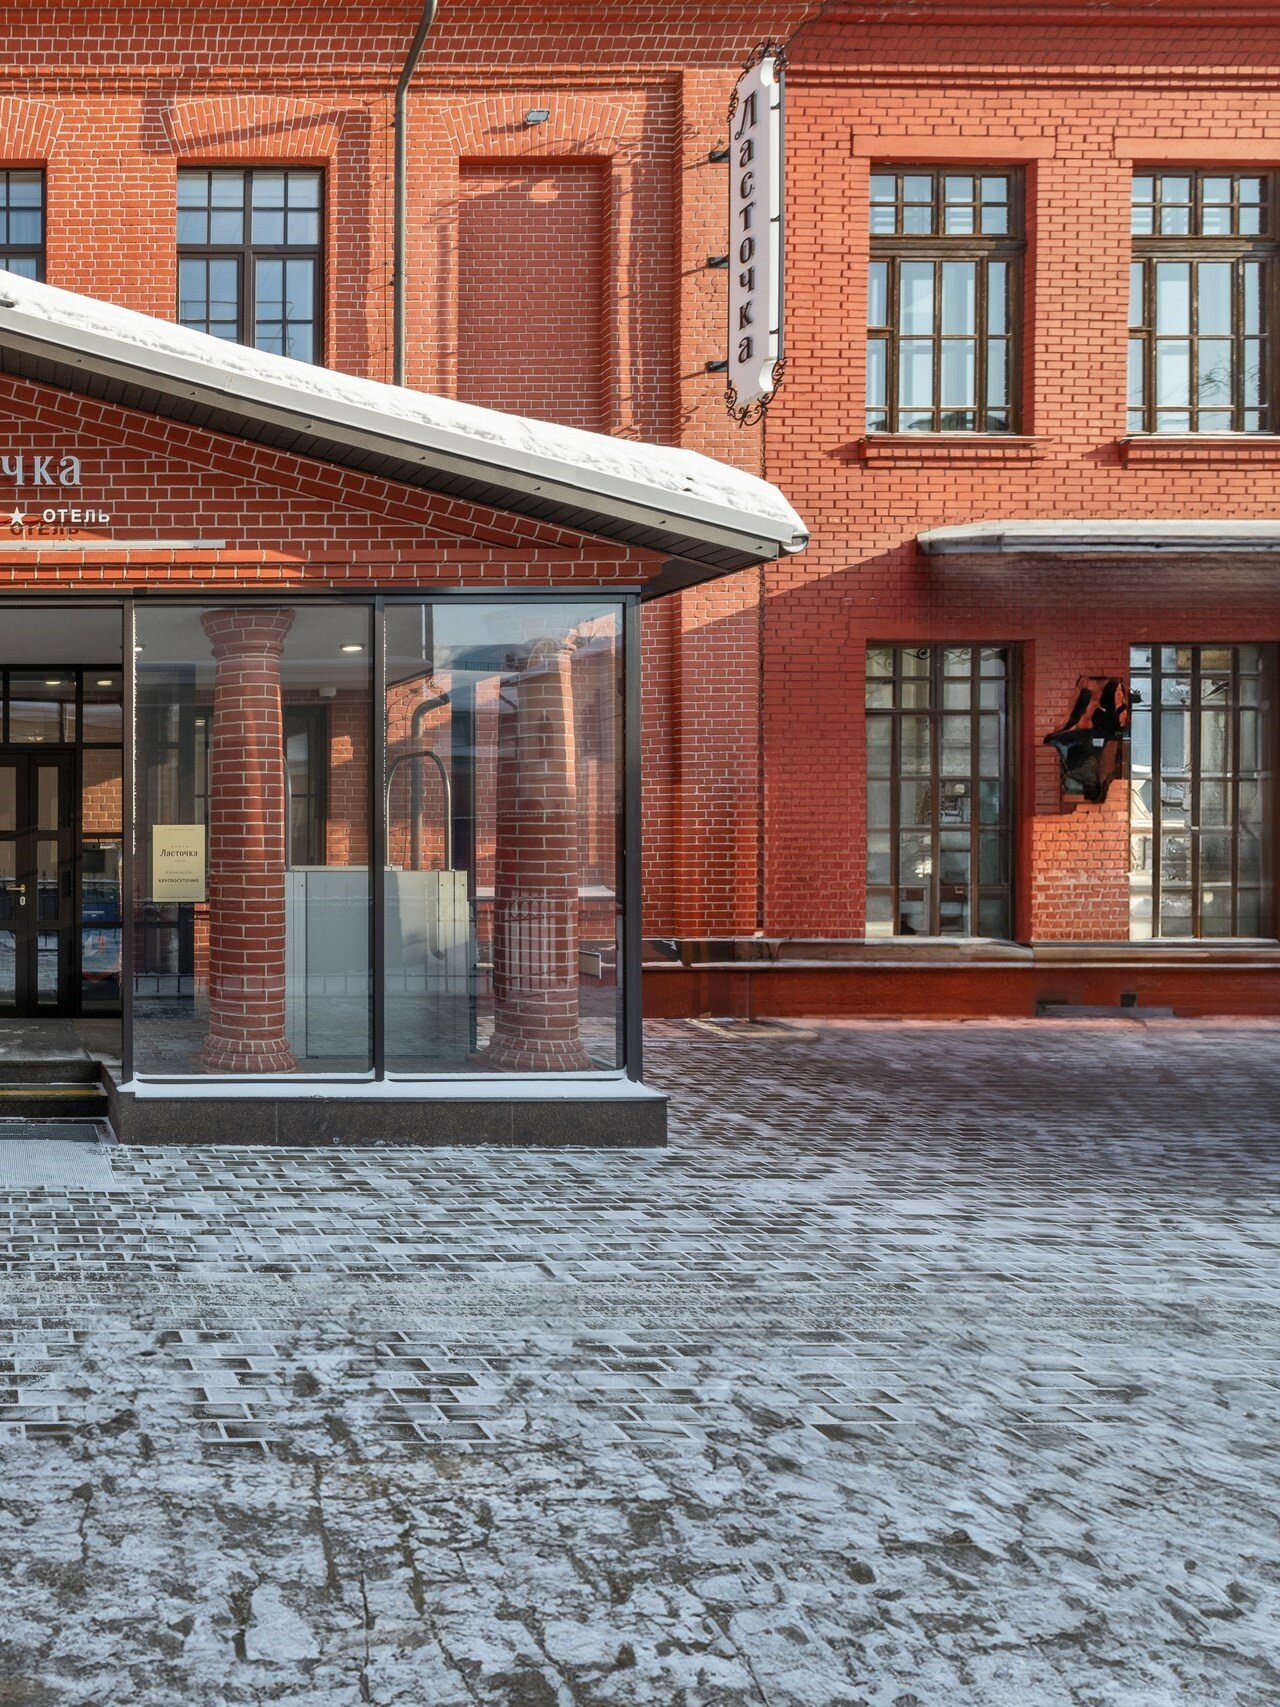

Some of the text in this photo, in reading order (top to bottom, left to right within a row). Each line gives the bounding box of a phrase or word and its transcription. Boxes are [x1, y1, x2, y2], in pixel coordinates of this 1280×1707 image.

[734, 89, 758, 364] Ласточка
[42, 508, 110, 523] ОТЕЛЬ
[159, 849, 198, 857] Ласточка
